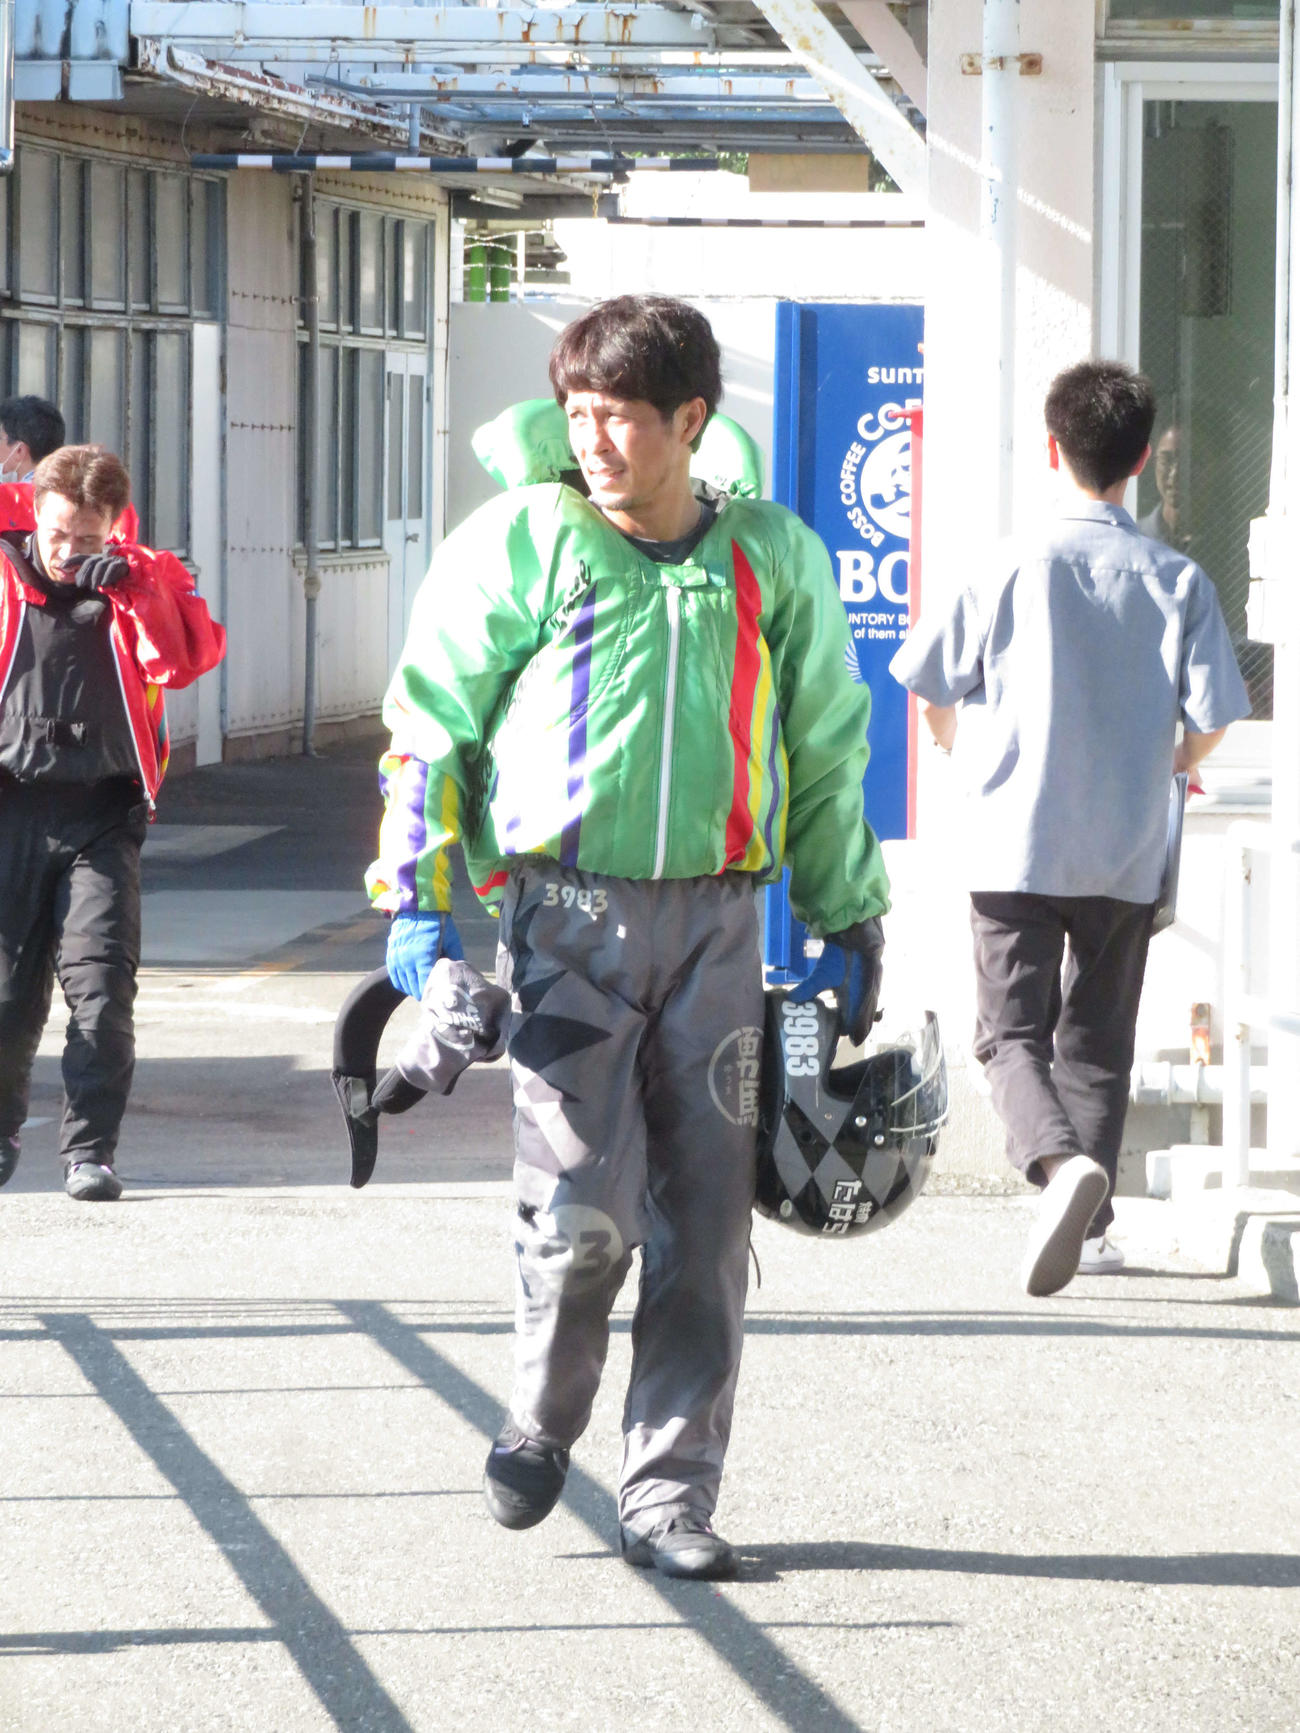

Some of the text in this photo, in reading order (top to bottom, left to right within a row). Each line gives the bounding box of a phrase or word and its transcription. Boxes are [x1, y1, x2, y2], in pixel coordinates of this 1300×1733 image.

[840, 441, 885, 547] BOSS COFFEE
[854, 627, 865, 639] of
[868, 627, 896, 639] them
[543, 883, 608, 913] 3983
[782, 1001, 820, 1077] 3983
